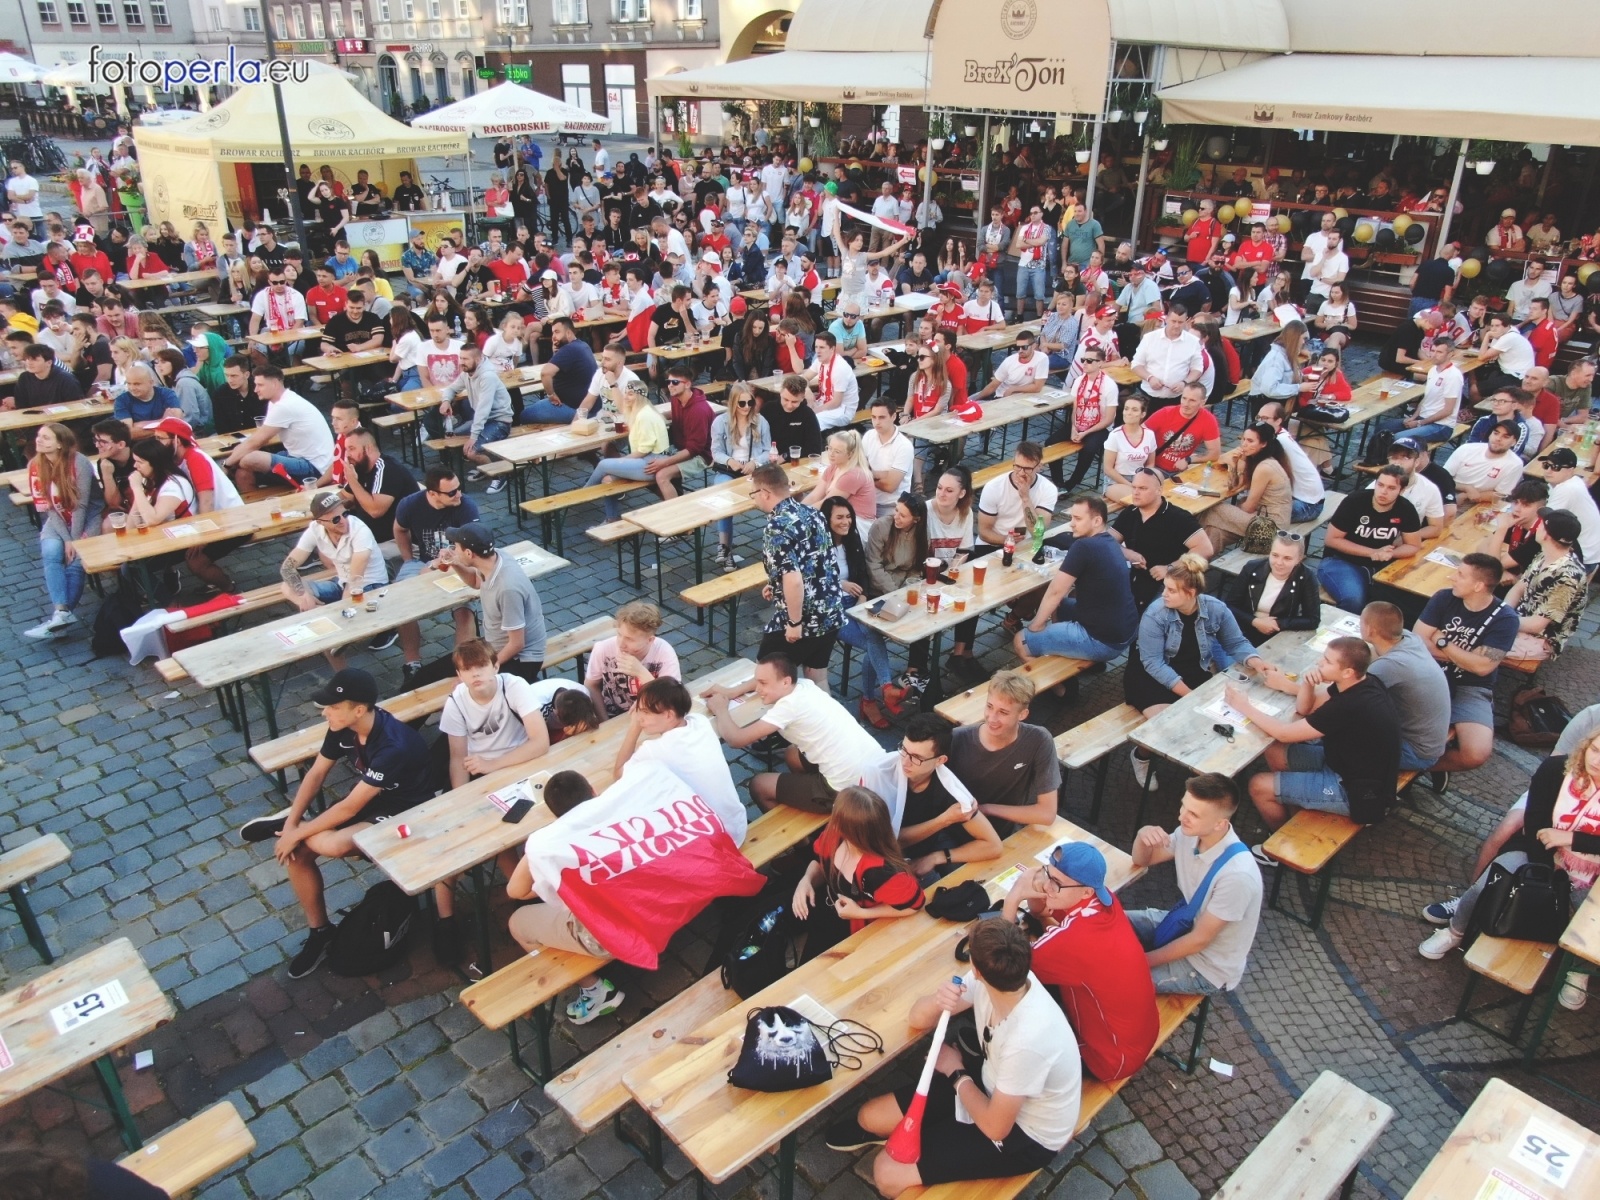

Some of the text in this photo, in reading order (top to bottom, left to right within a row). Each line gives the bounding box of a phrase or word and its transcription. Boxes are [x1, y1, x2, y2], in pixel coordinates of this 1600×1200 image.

[1292, 110, 1313, 119] Browar
[1314, 111, 1343, 122] Zamkowy
[1344, 113, 1373, 123] Racibórz
[483, 121, 550, 135] RACIBORSKIE
[564, 121, 606, 132] RACIBORSKIE
[220, 148, 257, 157] BROWAR
[313, 147, 385, 157] BROWAR RACIBÓRZ
[396, 145, 426, 154] BROWAR
[1354, 524, 1398, 540] NASA
[73, 992, 105, 1017] 15
[1523, 1134, 1570, 1168] 25
